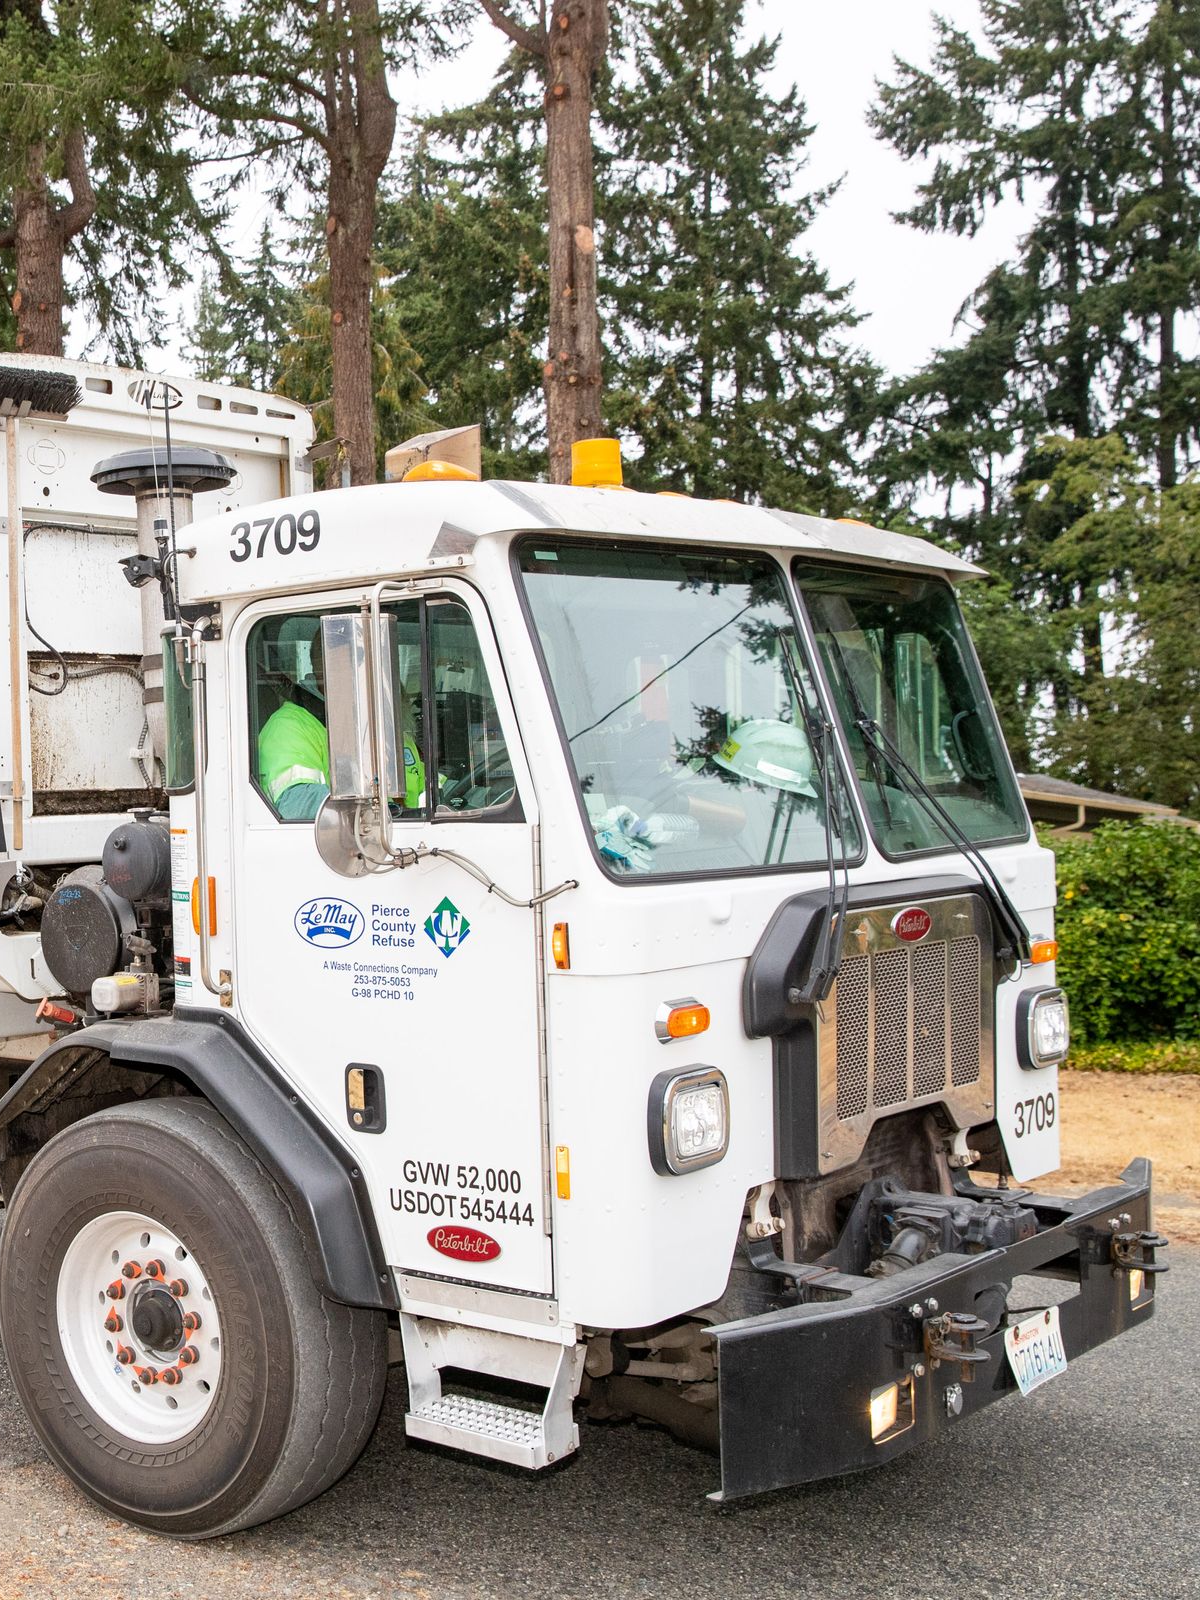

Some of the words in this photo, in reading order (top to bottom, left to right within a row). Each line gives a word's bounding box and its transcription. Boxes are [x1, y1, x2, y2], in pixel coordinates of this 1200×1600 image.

[229, 509, 321, 562] 3709
[301, 903, 358, 937] LeMay
[371, 904, 410, 917] Pierce
[371, 919, 417, 935] County
[372, 934, 415, 947] Refuse
[323, 961, 329, 970] A
[330, 961, 351, 971] Waste
[353, 962, 399, 974] Connections
[401, 965, 438, 977] Company
[354, 975, 411, 987] 253-875-5053
[351, 988, 372, 999] G-98
[374, 989, 401, 999] PCHD
[403, 991, 414, 1000] 10
[1014, 1092, 1055, 1139] 3709
[403, 1160, 450, 1187] GVW
[457, 1166, 521, 1195] 52,000
[390, 1188, 457, 1218] USDOT
[460, 1197, 535, 1227] 545444
[434, 1229, 494, 1255] Peterbilt
